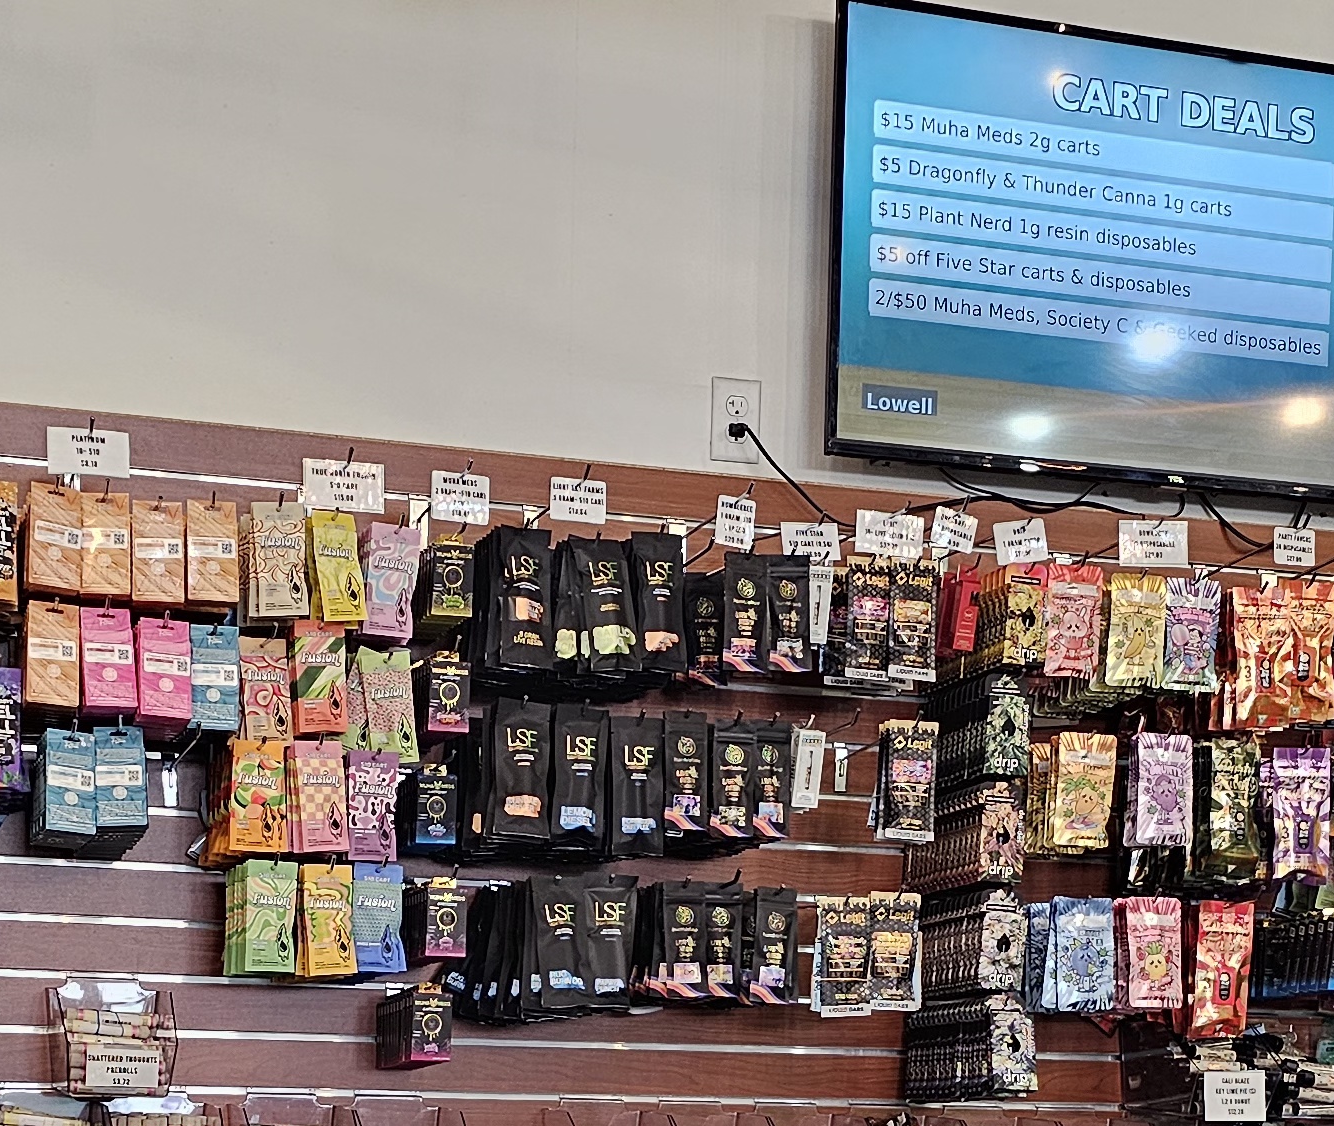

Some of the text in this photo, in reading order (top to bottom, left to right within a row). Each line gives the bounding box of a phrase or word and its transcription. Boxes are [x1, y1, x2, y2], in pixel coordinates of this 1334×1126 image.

[1052, 72, 1316, 144] CART DEALS
[880, 111, 1100, 156] $15 Muha Meds 2g carts
[879, 156, 1232, 217] $5 Dragonfly & Thunder Canna 1g carts
[878, 200, 1197, 256] $15 Plant Nerd 1g resin disposables
[876, 245, 1191, 298] $5 off Five Star carts & disposables
[875, 288, 927, 311] 2/$50
[934, 296, 982, 317] Muha
[989, 302, 1040, 326] Meds,
[1046, 309, 1111, 335] Society
[1116, 317, 1128, 334] C
[1223, 330, 1322, 356] disposables
[866, 392, 934, 416] Lowell
[373, 555, 415, 575] Fusion
[300, 650, 342, 667] Fusion
[1012, 643, 1038, 663] drip
[355, 894, 397, 911] Fusion
[594, 900, 627, 923] LSF
[87, 1053, 158, 1065] SHATTERED THOUGHTS
[105, 1065, 139, 1076] PREROLLS
